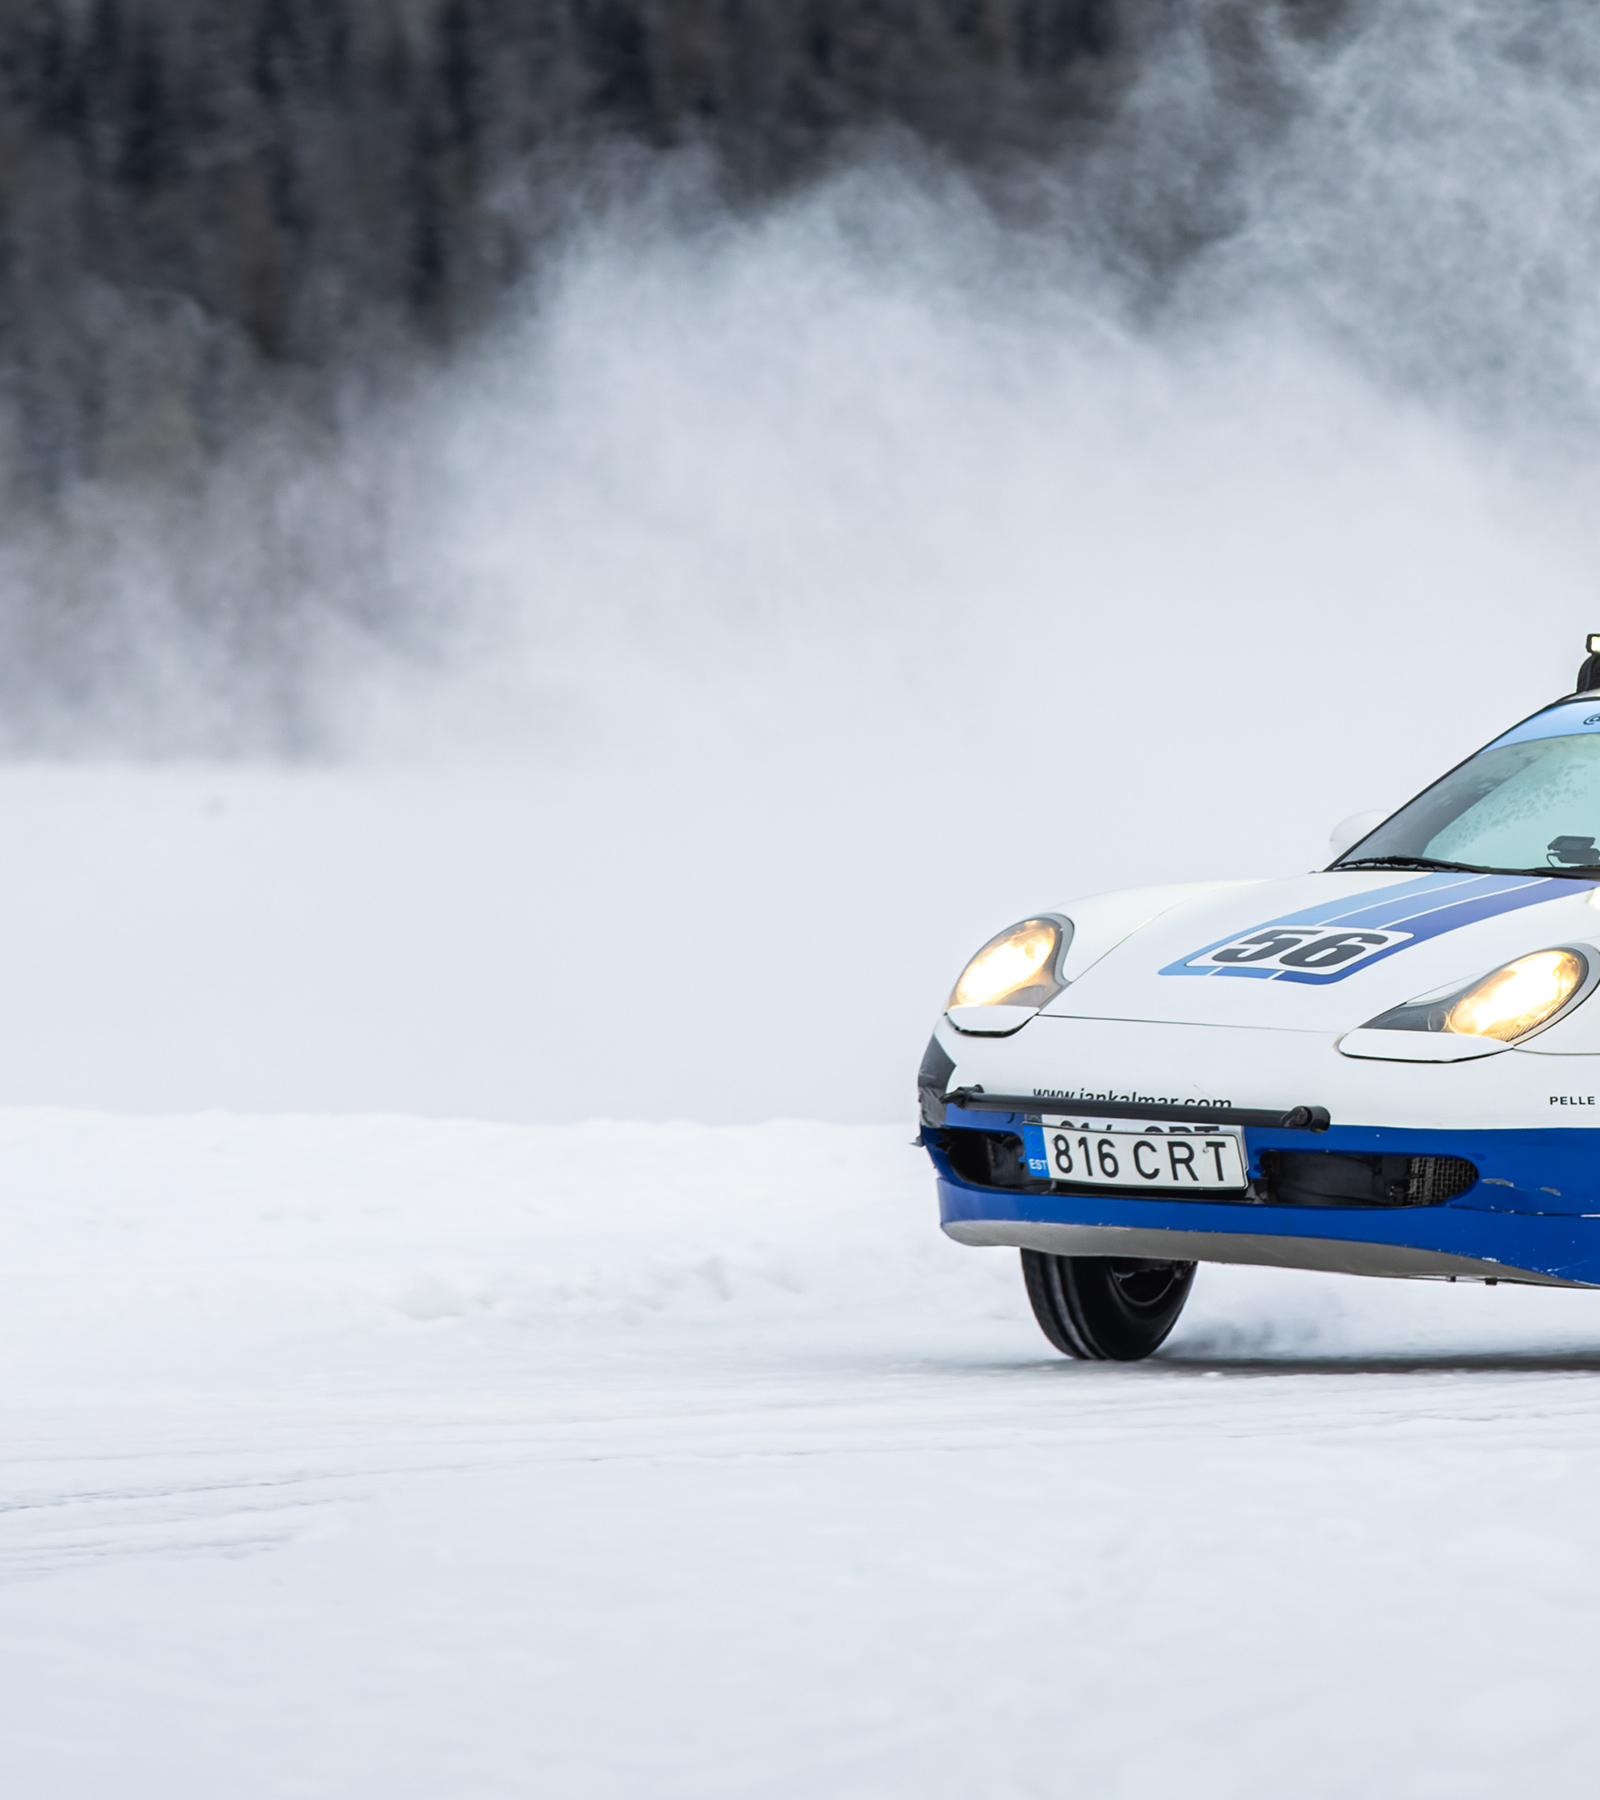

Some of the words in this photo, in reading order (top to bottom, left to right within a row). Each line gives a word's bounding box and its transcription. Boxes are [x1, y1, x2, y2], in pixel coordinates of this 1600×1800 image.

[1212, 928, 1389, 968] 56
[1032, 1087, 1232, 1107] wwwjankalmarcom
[1549, 1095, 1596, 1106] PELLE
[1029, 1158, 1048, 1171] EST
[1053, 1133, 1119, 1179] 816
[1132, 1139, 1227, 1182] CRT
